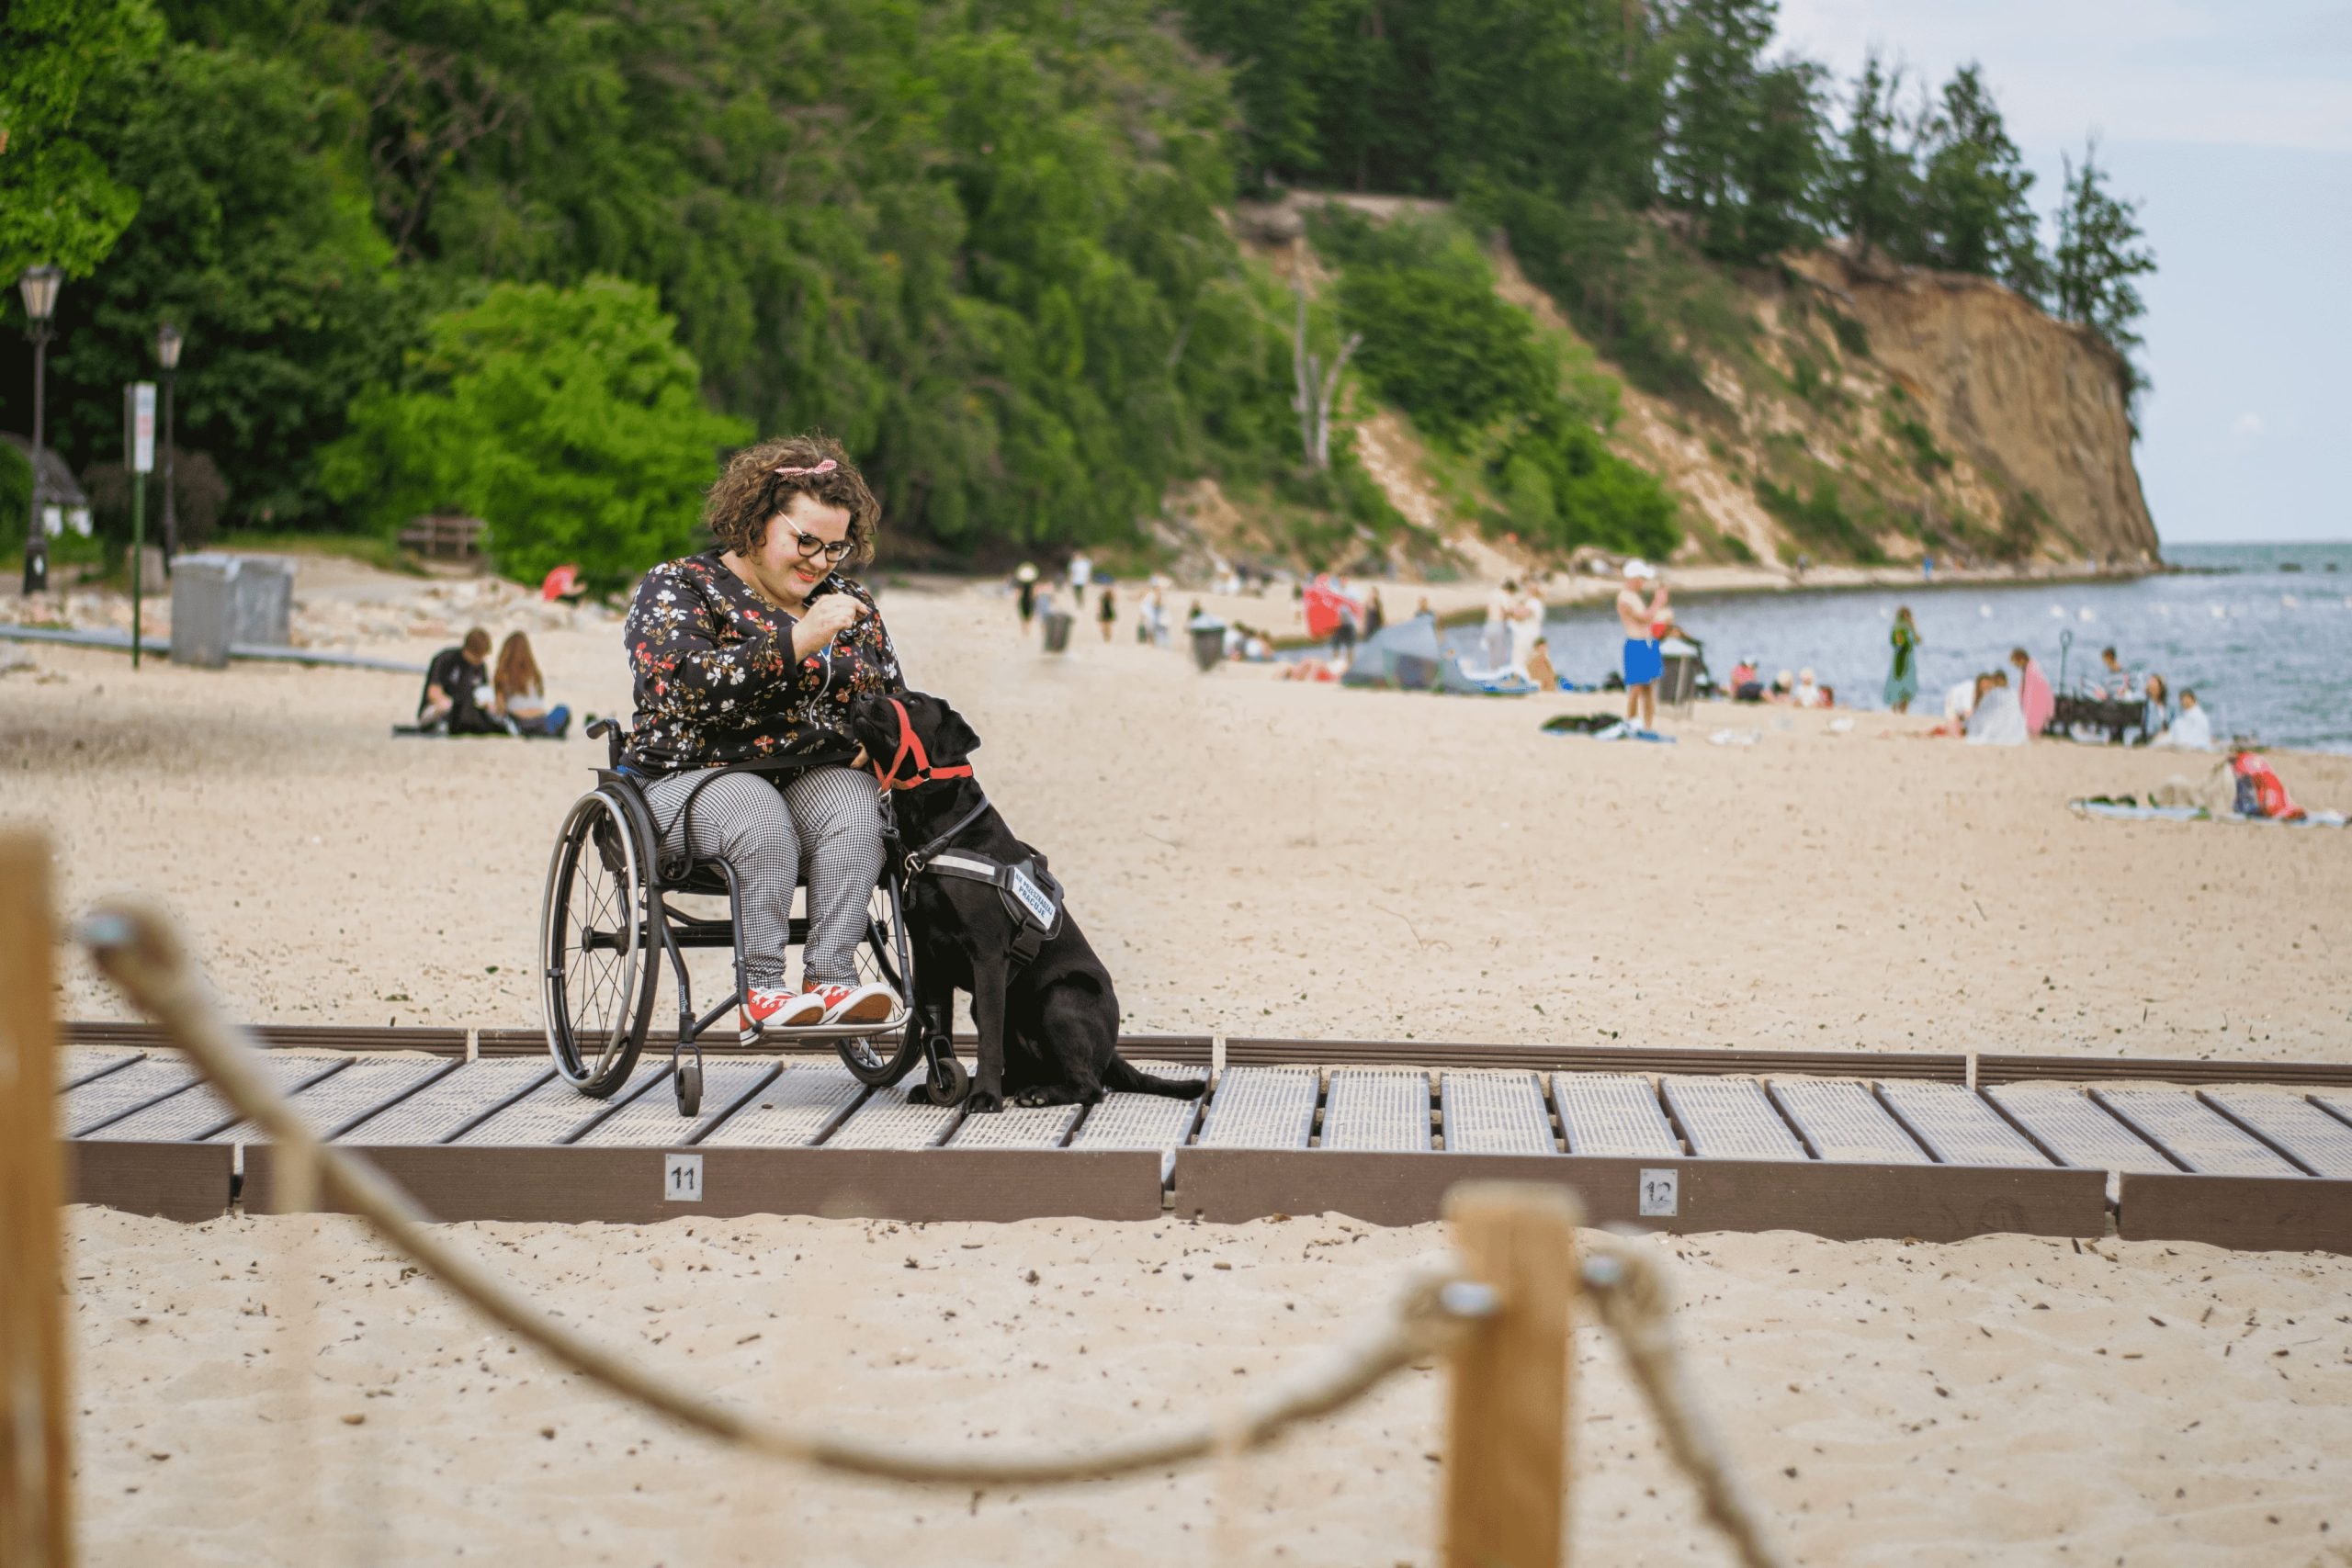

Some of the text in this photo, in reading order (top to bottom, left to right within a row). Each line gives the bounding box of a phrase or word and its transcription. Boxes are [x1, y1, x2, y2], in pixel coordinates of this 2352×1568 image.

[1018, 886, 1046, 919] PRACUJE
[671, 1166, 694, 1190] 11
[1645, 1181, 1671, 1202] 12
